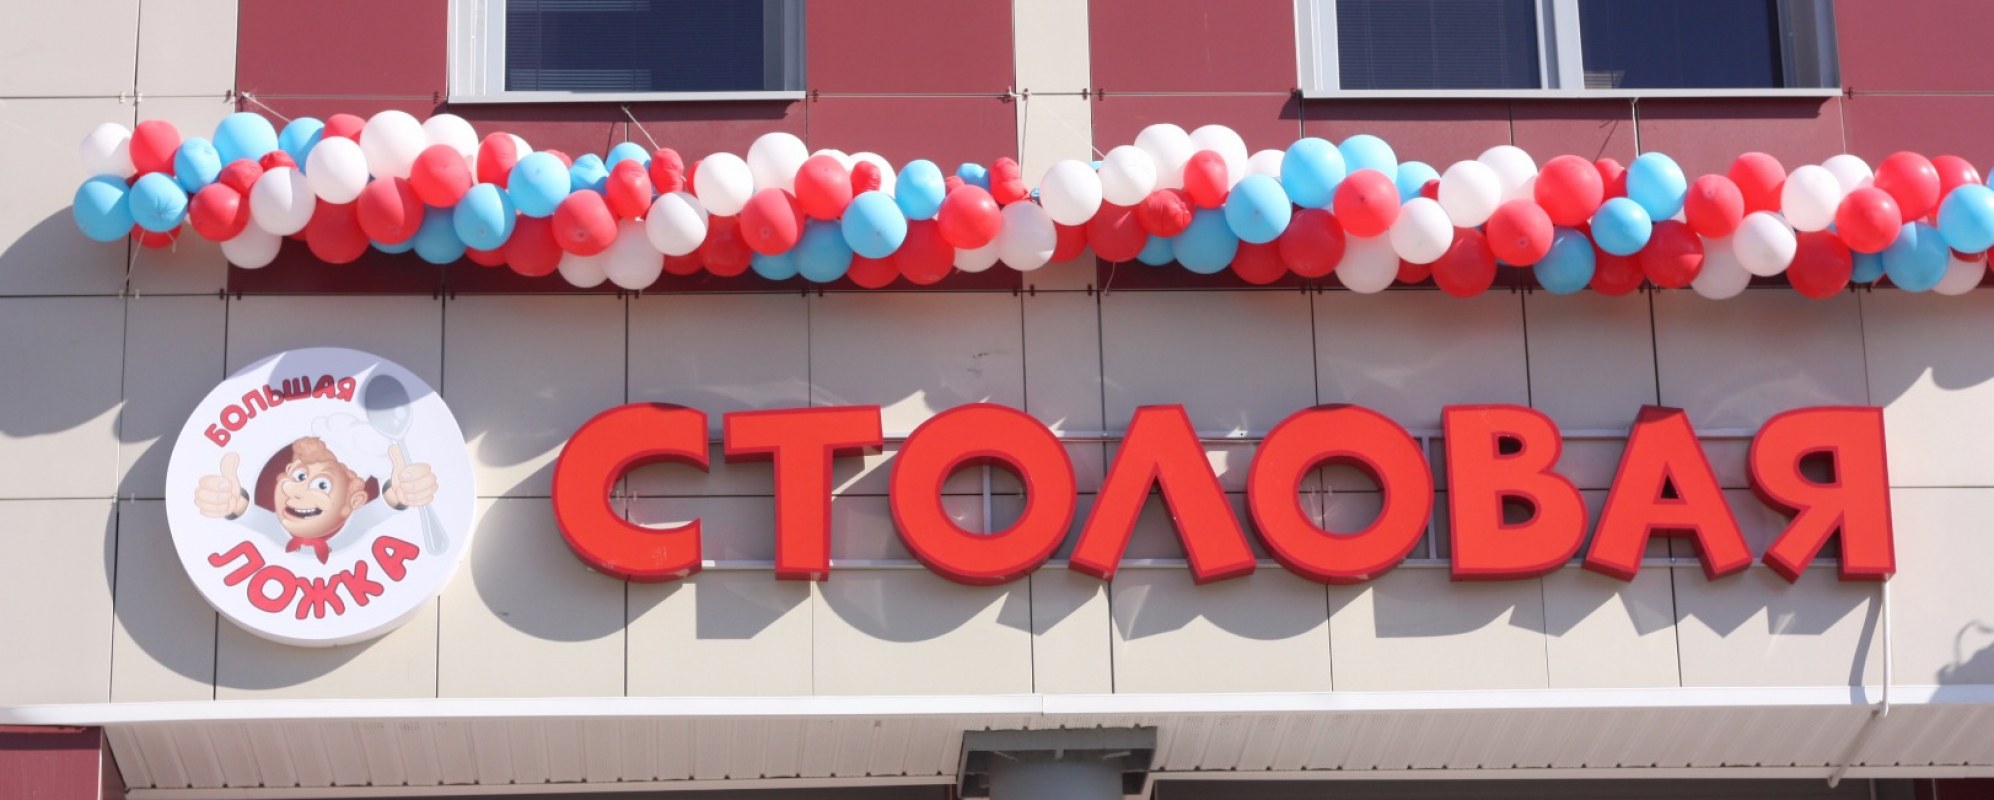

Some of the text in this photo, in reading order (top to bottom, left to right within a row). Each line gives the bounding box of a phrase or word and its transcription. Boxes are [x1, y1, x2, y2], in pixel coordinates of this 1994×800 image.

[204, 374, 356, 448] БОЛЬШАЯ
[551, 402, 1897, 586] СТОЛОВАЯ
[207, 535, 420, 620] ЛОЖКА
